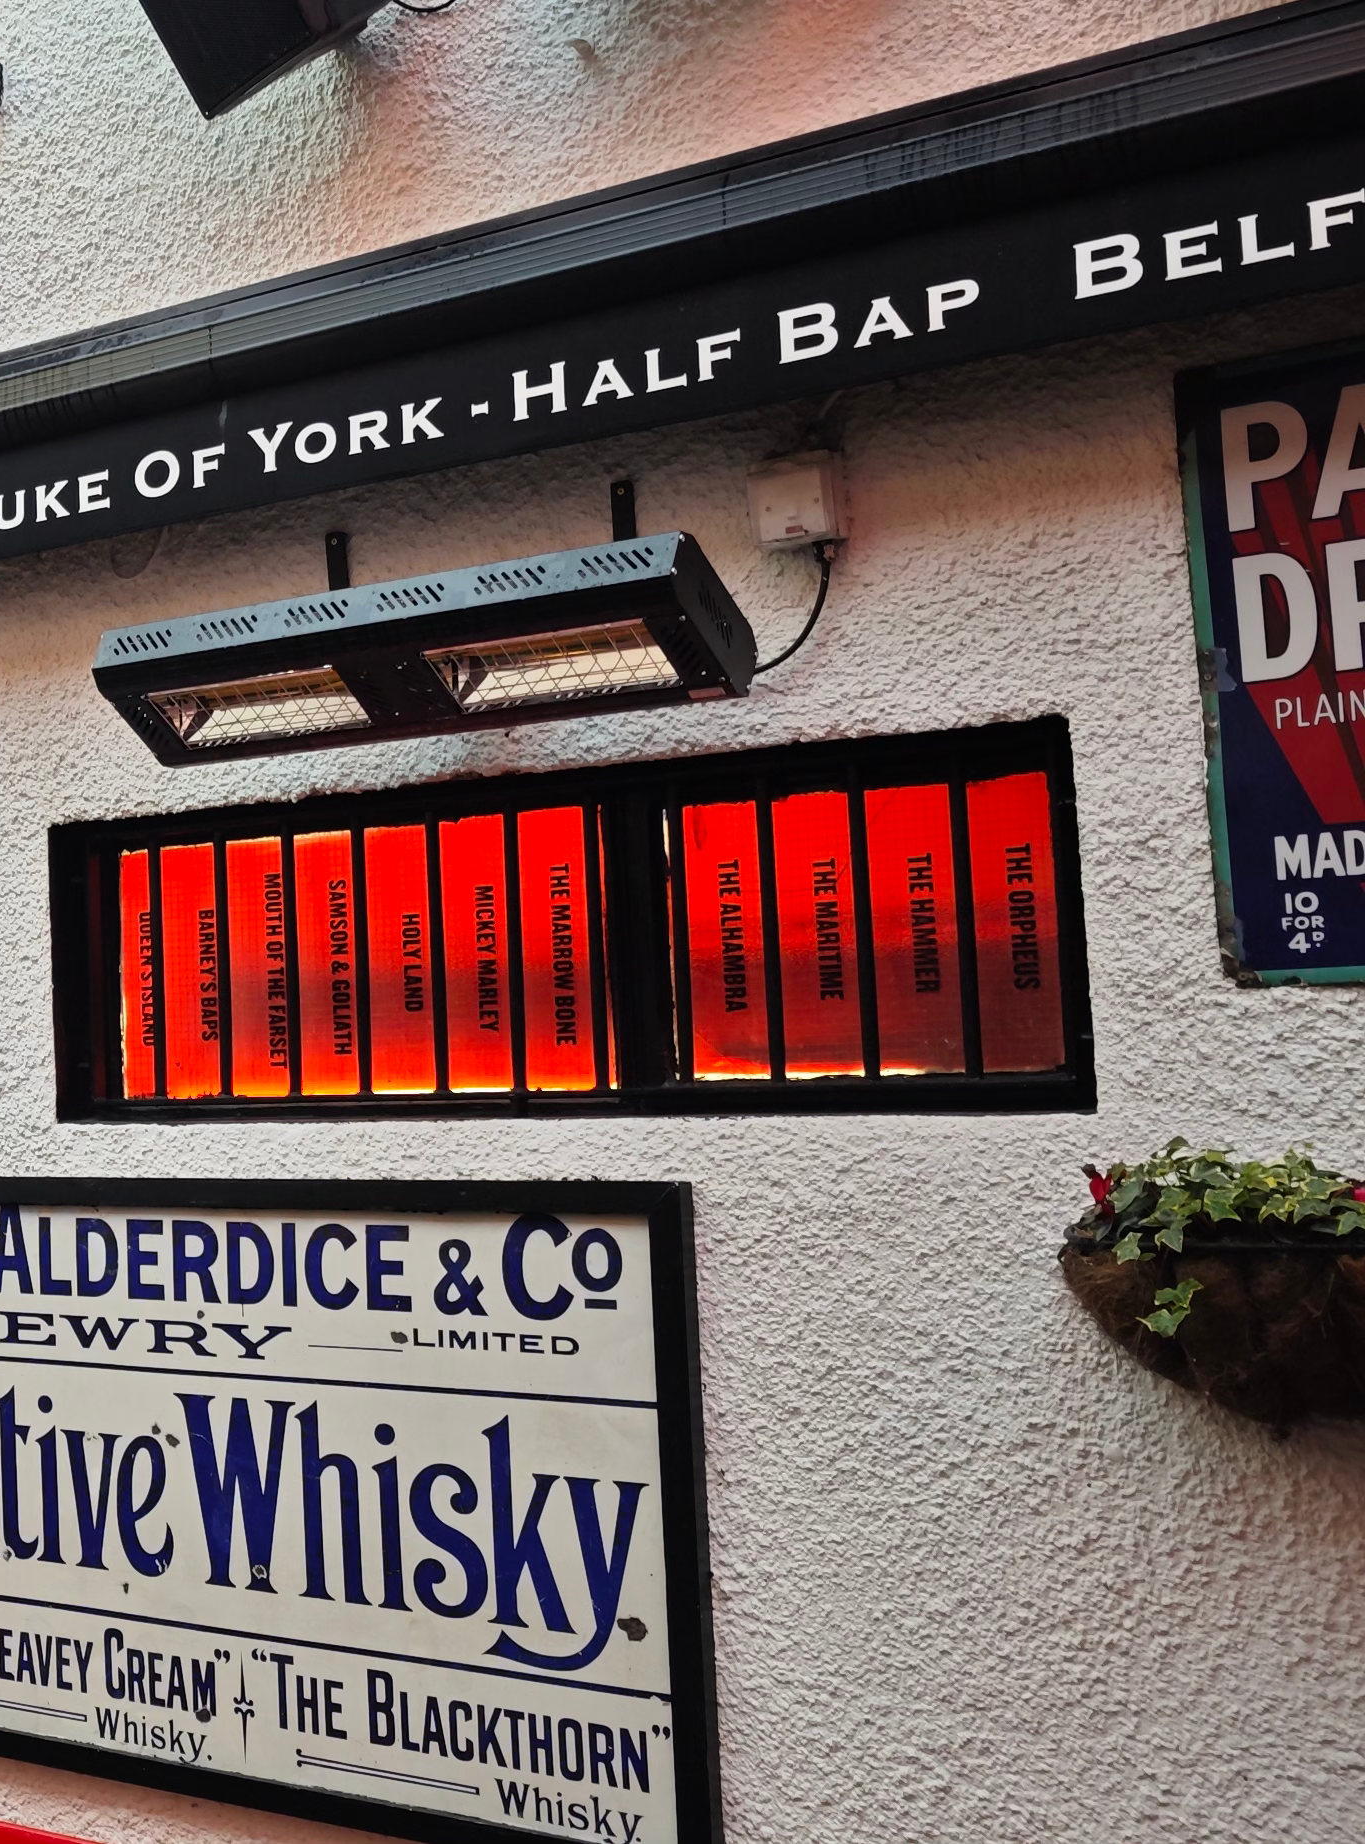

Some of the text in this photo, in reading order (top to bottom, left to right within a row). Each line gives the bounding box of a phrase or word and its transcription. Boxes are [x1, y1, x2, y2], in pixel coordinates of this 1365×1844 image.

[134, 443, 225, 499] OF
[248, 396, 445, 474] YORK
[512, 328, 741, 421] HALF
[777, 278, 980, 365] BAP
[198, 908, 218, 1042] BARNEY'S BAPS
[263, 873, 288, 1069] MOUTH OF THE FARSET
[329, 878, 354, 1056] SAMSON & GOLIATH
[401, 913, 424, 1013] HOLY LAND
[474, 885, 499, 1034] MICKEY MARLEY
[549, 863, 577, 1047] THE MARROW BONE
[717, 859, 748, 1013] THE ALHAMBRA
[811, 858, 844, 1001] THE MARITIME
[907, 852, 941, 994] THE HAMMER
[1005, 842, 1040, 990] THE ORPHEUS
[1281, 916, 1326, 932] FOR
[412, 1327, 580, 1356] LIMITED
[433, 1238, 488, 1317] &
[173, 1393, 649, 1671] Whisky
